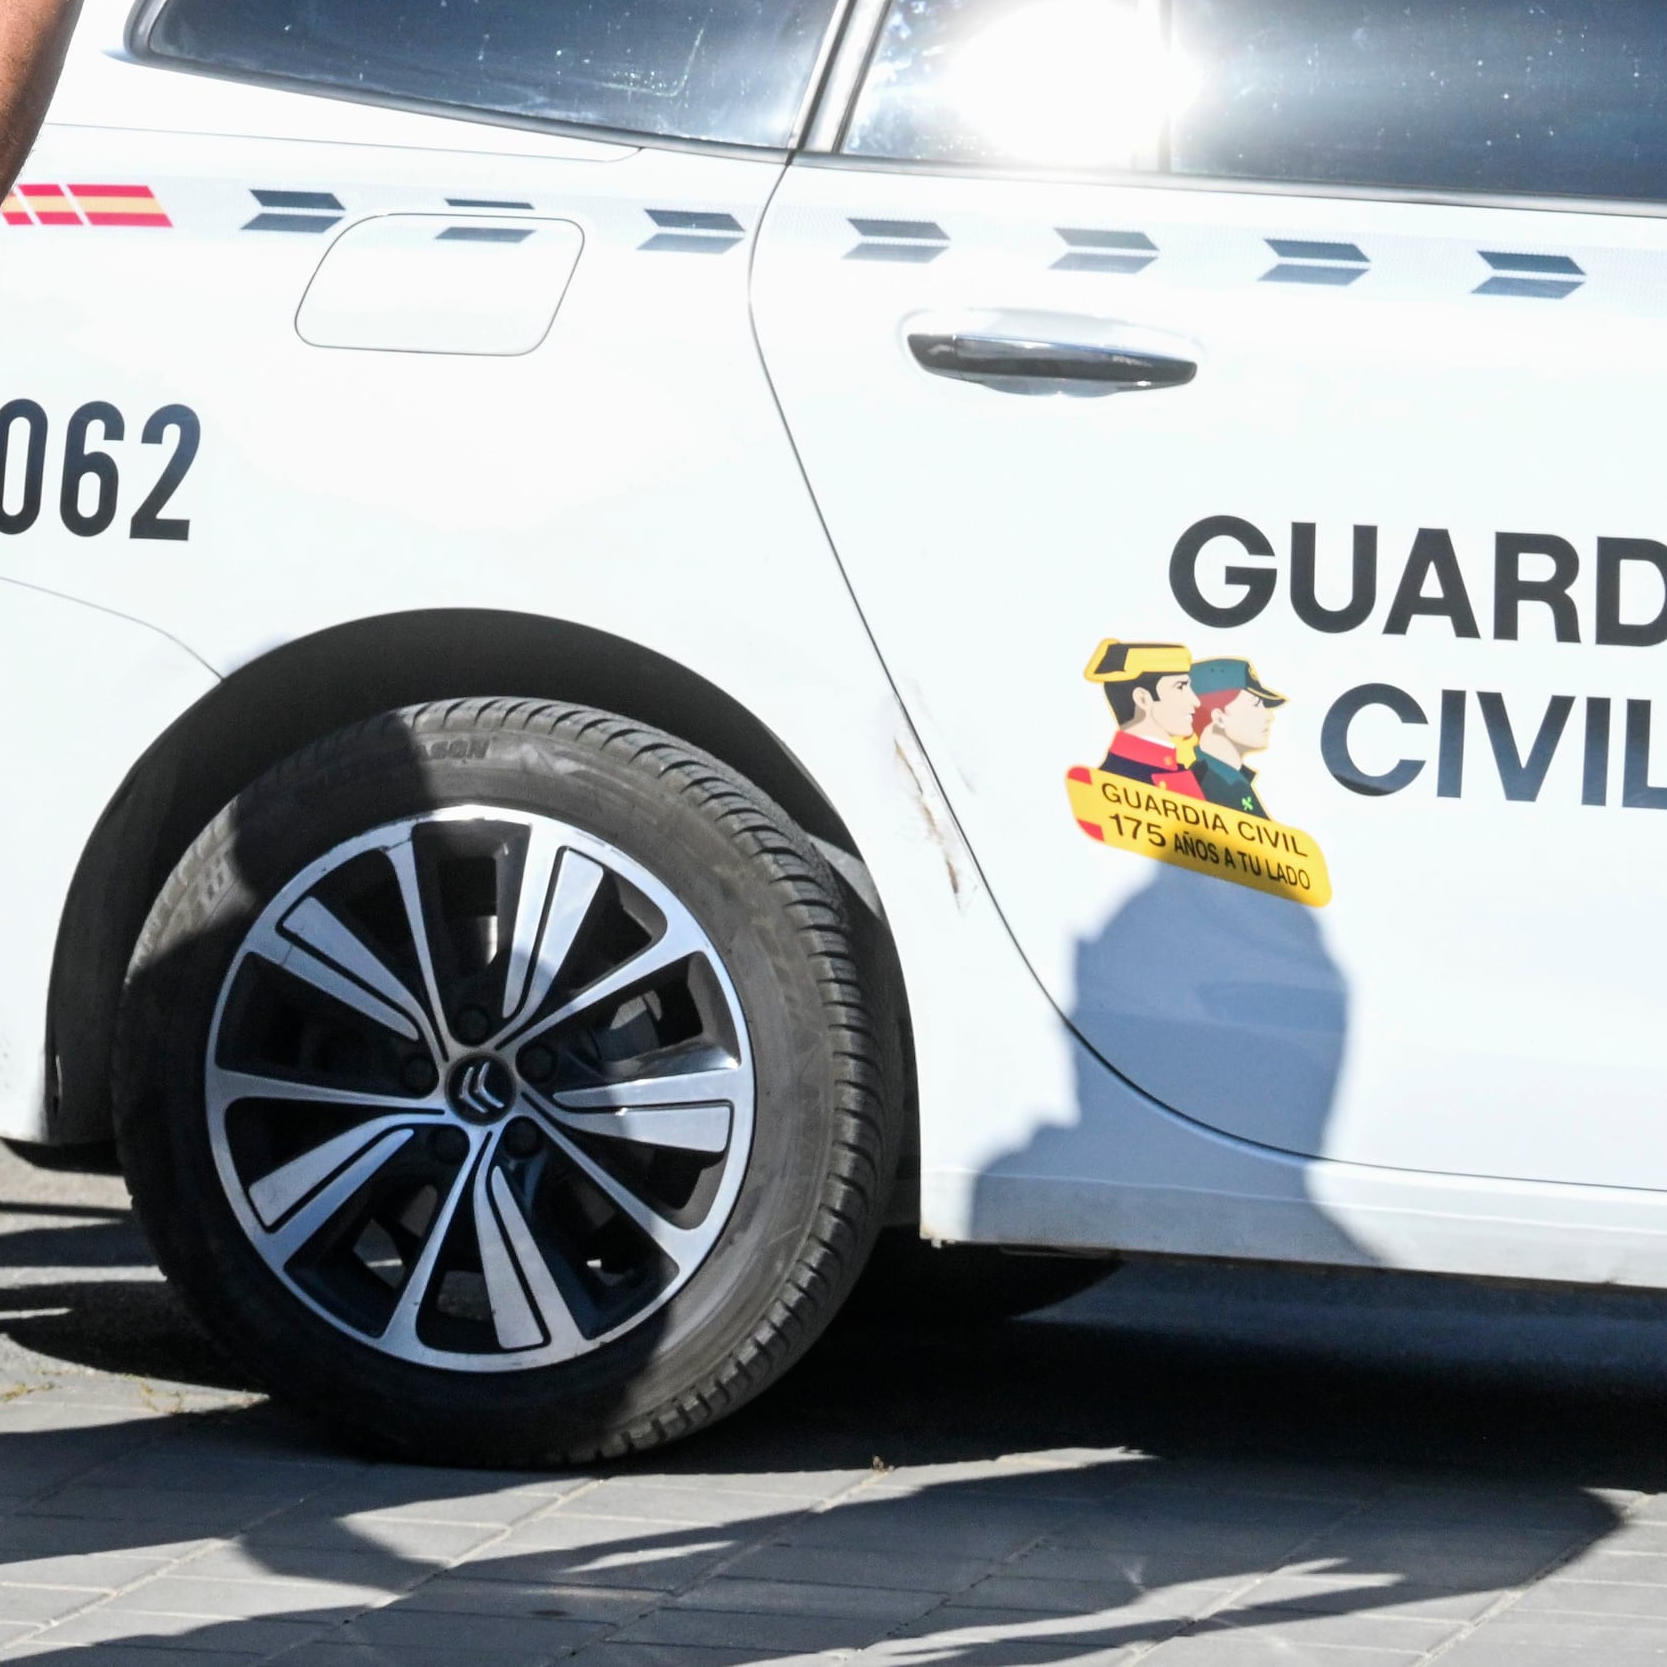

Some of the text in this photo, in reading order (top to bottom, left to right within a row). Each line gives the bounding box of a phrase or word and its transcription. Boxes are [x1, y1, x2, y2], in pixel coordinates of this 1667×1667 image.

[1320, 682, 1667, 810] CIVIL
[1101, 783, 1308, 857] GUARDIA CIVIL
[1109, 813, 1311, 890] 175 AÑOS A TU LADO
